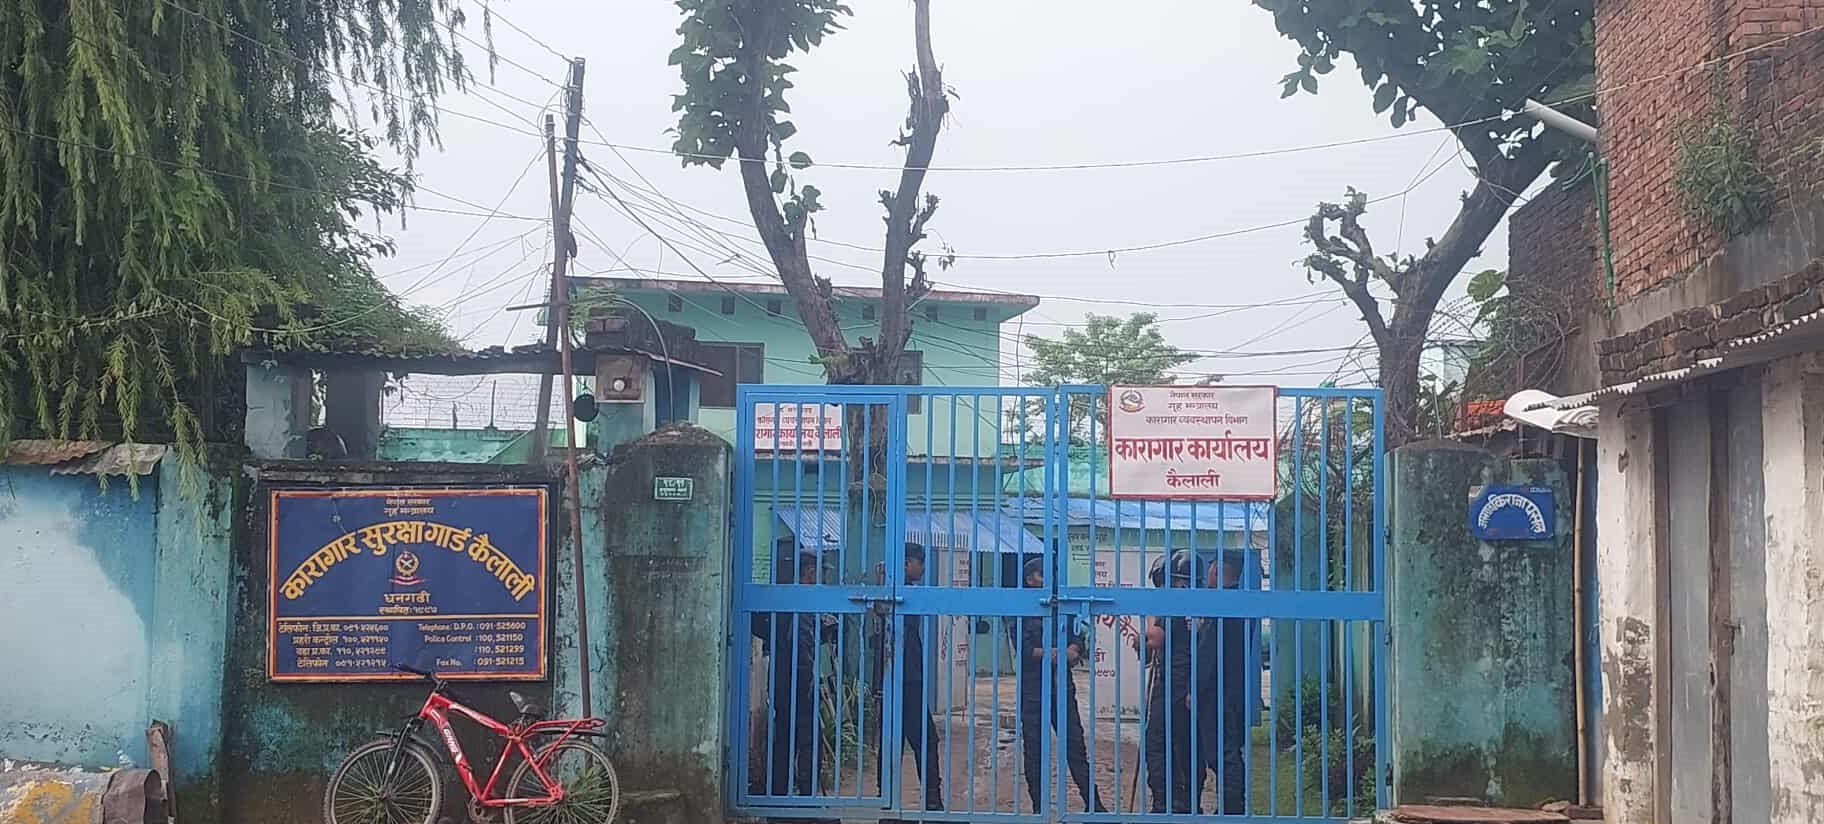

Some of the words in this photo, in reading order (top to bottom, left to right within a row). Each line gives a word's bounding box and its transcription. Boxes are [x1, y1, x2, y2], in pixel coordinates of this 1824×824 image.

[1191, 391, 1215, 399] सरकार
[1167, 402, 1182, 413] गृह
[1145, 415, 1177, 425] कारागार
[1178, 415, 1223, 425] व्यवस्थापन
[1224, 413, 1248, 425] विभाग
[1115, 437, 1185, 463] कारागार
[1186, 430, 1271, 463] कार्यालय
[1166, 468, 1221, 489] कैलाली
[279, 531, 362, 600] कारागार
[357, 520, 426, 556] सुरक्षा
[424, 521, 473, 552] गार्ड
[467, 533, 536, 601] कैलाली
[384, 590, 431, 603] धनगढी
